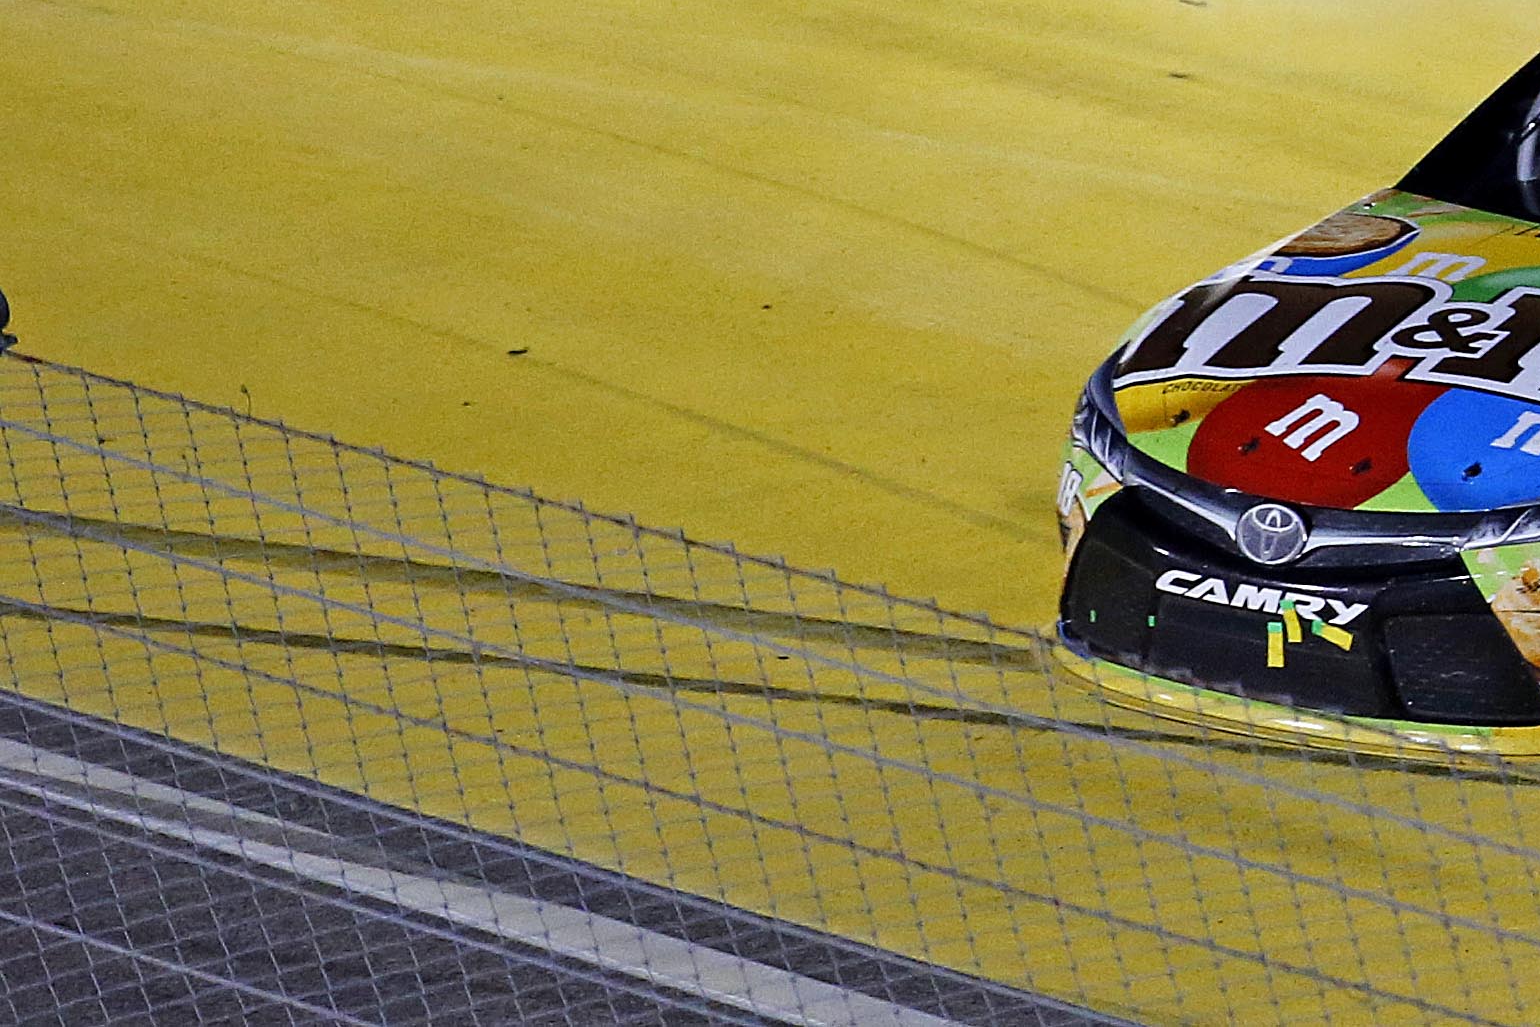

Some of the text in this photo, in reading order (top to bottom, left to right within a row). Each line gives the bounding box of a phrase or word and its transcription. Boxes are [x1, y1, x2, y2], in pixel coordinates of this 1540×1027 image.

[1162, 380, 1243, 394] CHOCOLAT
[1264, 392, 1360, 462] m
[1155, 569, 1369, 625] CAMRY
